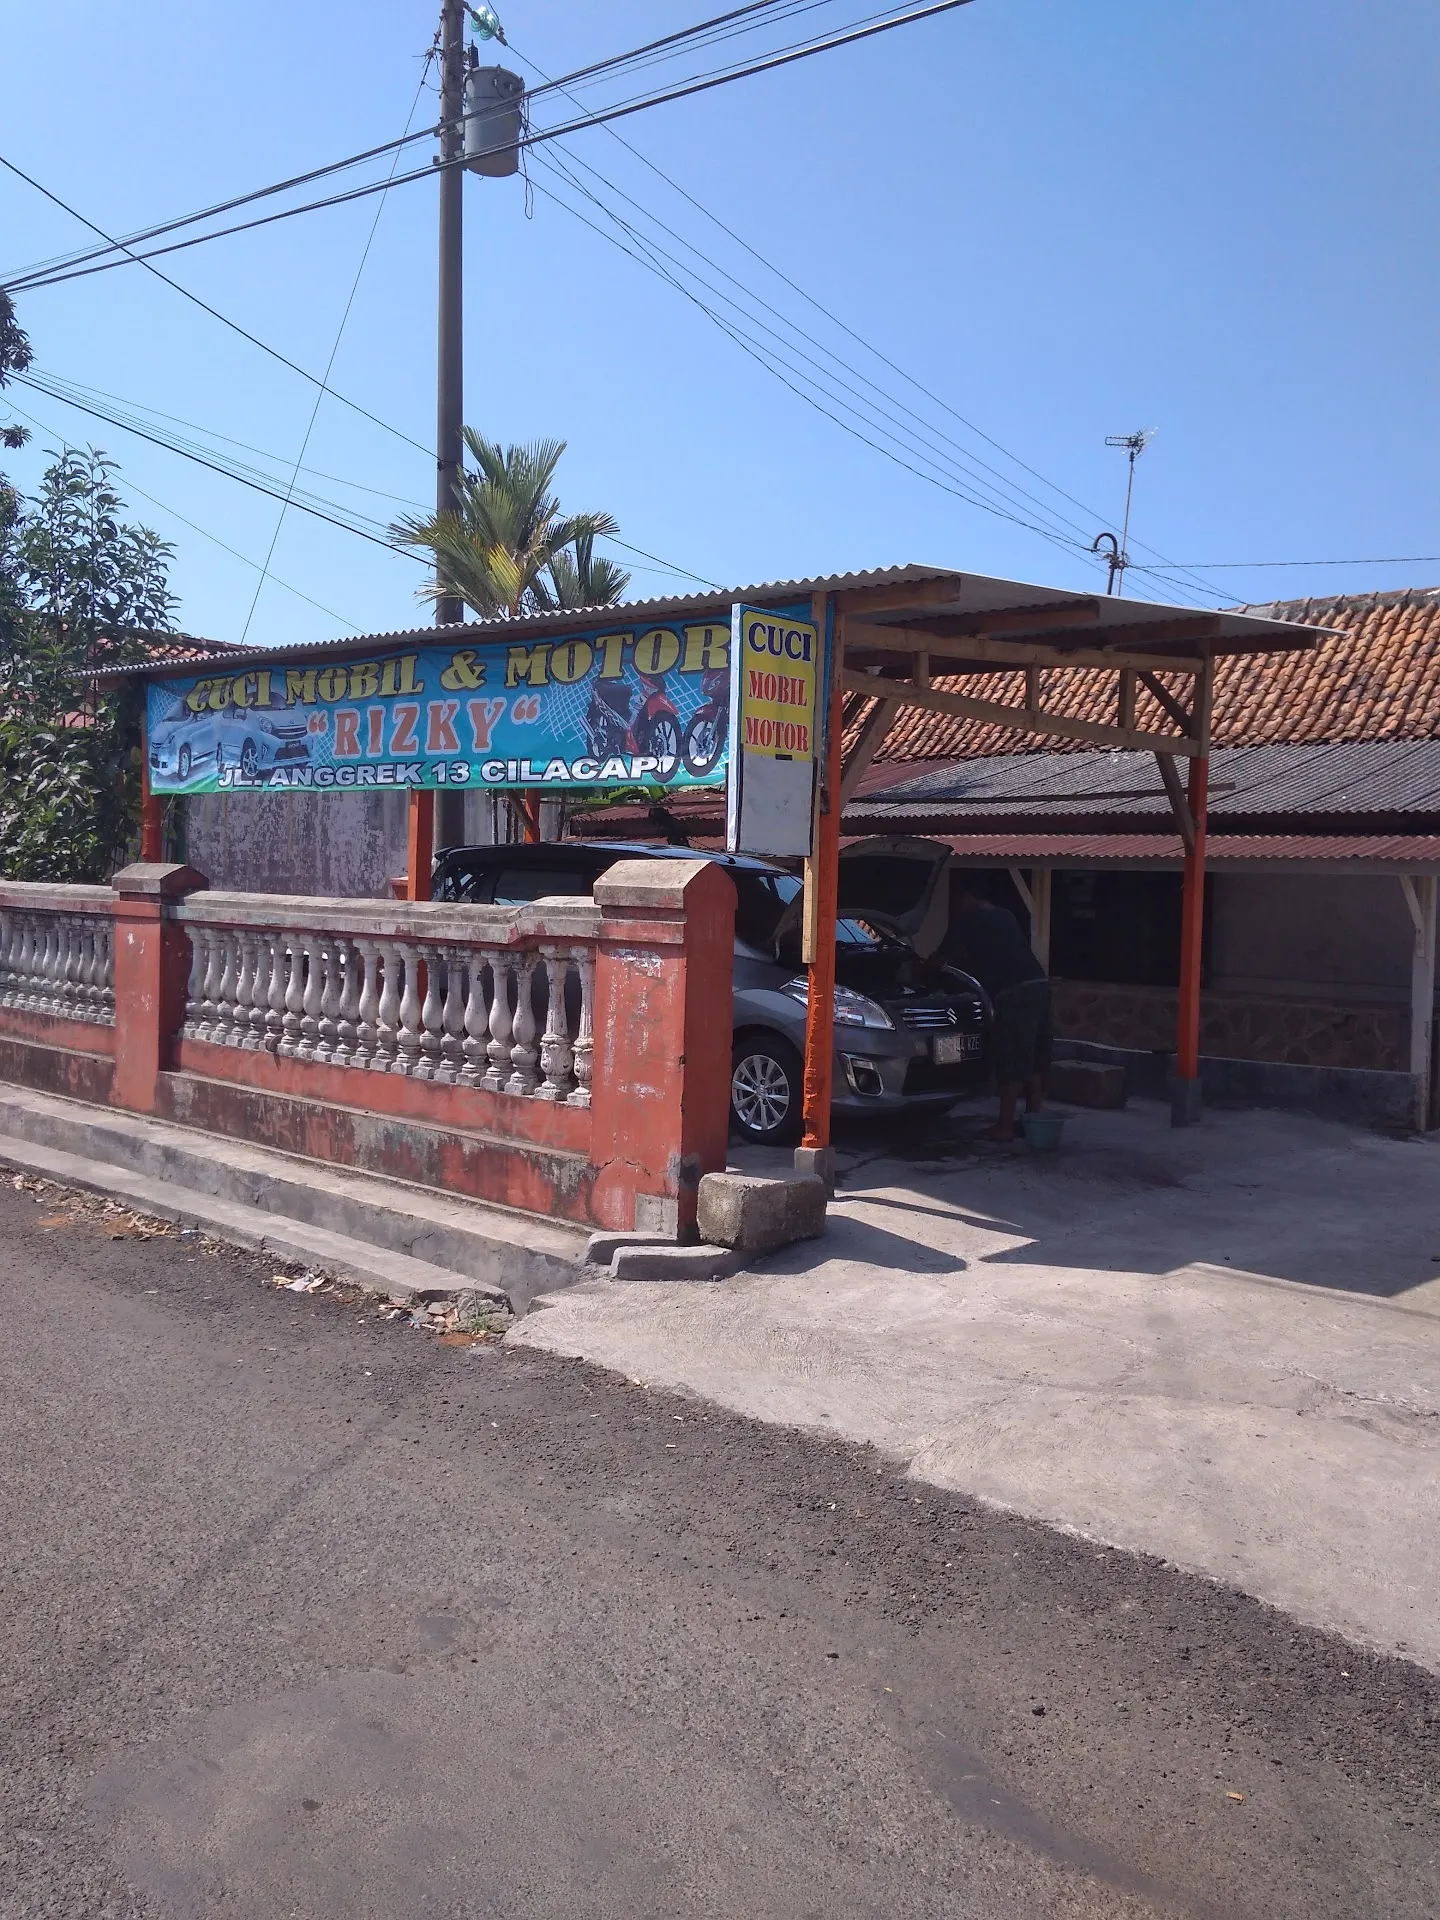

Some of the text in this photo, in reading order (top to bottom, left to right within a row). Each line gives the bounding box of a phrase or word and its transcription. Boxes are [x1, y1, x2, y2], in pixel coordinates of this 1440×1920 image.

[748, 622, 812, 662] CUCI
[187, 622, 731, 712] CUCI MOBIL & MOTOR
[748, 670, 808, 707] MOBIL
[745, 716, 809, 753] MOTOR
[218, 755, 660, 788] JL. ANGGREK 13 CILACAP
